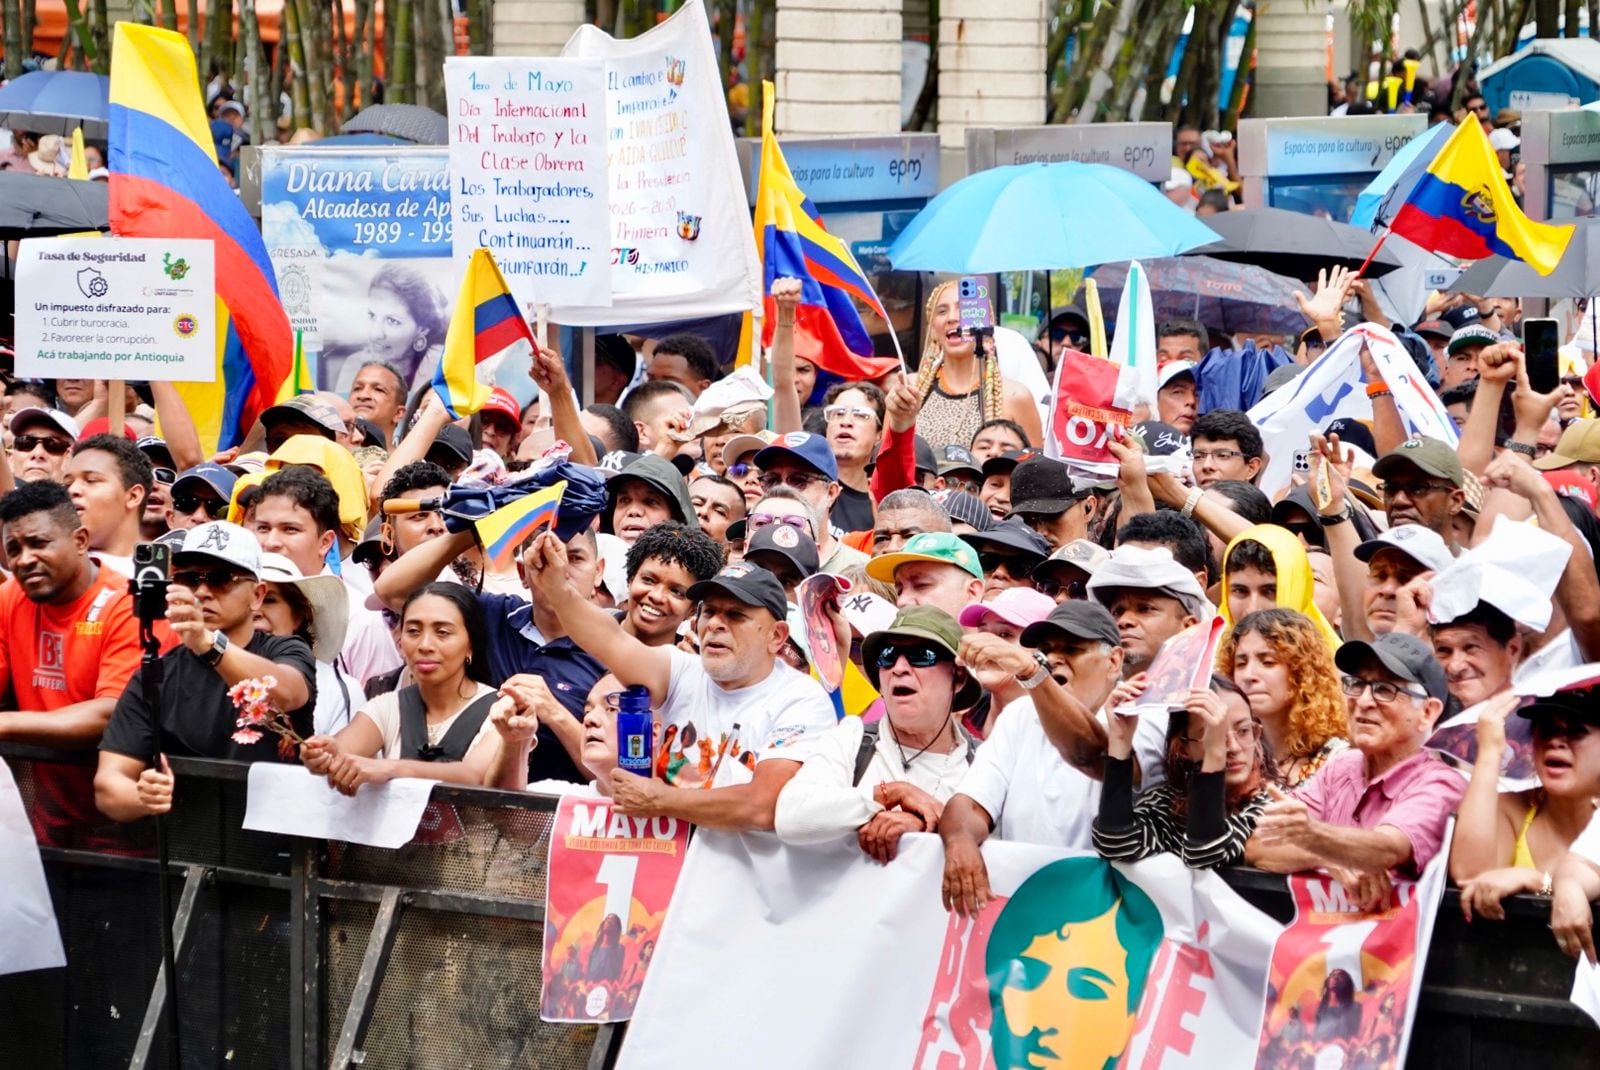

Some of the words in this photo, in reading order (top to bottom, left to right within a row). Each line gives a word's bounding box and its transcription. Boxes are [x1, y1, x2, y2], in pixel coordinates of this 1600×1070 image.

[504, 75, 518, 90] de
[528, 71, 573, 94] Mayo
[608, 71, 619, 90] El
[459, 98, 481, 117] Día
[494, 98, 587, 118] Internacional
[458, 124, 480, 143] Del
[491, 124, 546, 146] Trabajo
[554, 132, 563, 148] y
[570, 128, 587, 145] la
[1562, 131, 1587, 149] Espacios
[1124, 145, 1155, 168] epm
[1284, 140, 1317, 156] Espacios
[1317, 143, 1336, 156] para
[1337, 140, 1345, 153] la
[1346, 139, 1373, 153] cultura
[481, 151, 529, 170] Clase
[534, 152, 585, 171] Obrera
[809, 169, 831, 184] para
[832, 164, 842, 178] la
[843, 163, 875, 178] cultura
[889, 158, 922, 183] epm
[286, 162, 374, 193] Diana
[382, 162, 451, 192] Card
[461, 177, 485, 196] Los
[493, 178, 595, 202] Trabajadores,
[302, 197, 391, 219] Alcadesa
[396, 198, 420, 217] de
[423, 196, 452, 223] Ap
[462, 205, 484, 223] Sus
[353, 222, 401, 244] 1989
[422, 221, 454, 243] 199
[38, 252, 66, 261] Tasa
[67, 252, 81, 262] de
[83, 252, 146, 264] Seguridad
[35, 302, 49, 311] Un
[50, 302, 94, 314] impuesto
[96, 303, 145, 313] disfrazado
[147, 305, 171, 315] para:
[51, 317, 79, 327] Cubrir
[80, 318, 130, 328] burocracia.
[177, 320, 195, 329] CTC
[51, 333, 94, 343] Favorecer
[96, 334, 104, 343] la
[105, 334, 157, 346] corrupción.
[37, 350, 57, 359] Acá
[59, 350, 112, 361] trabajando
[114, 353, 131, 363] por
[134, 352, 185, 363] Antioquia
[570, 804, 678, 841] MAYO
